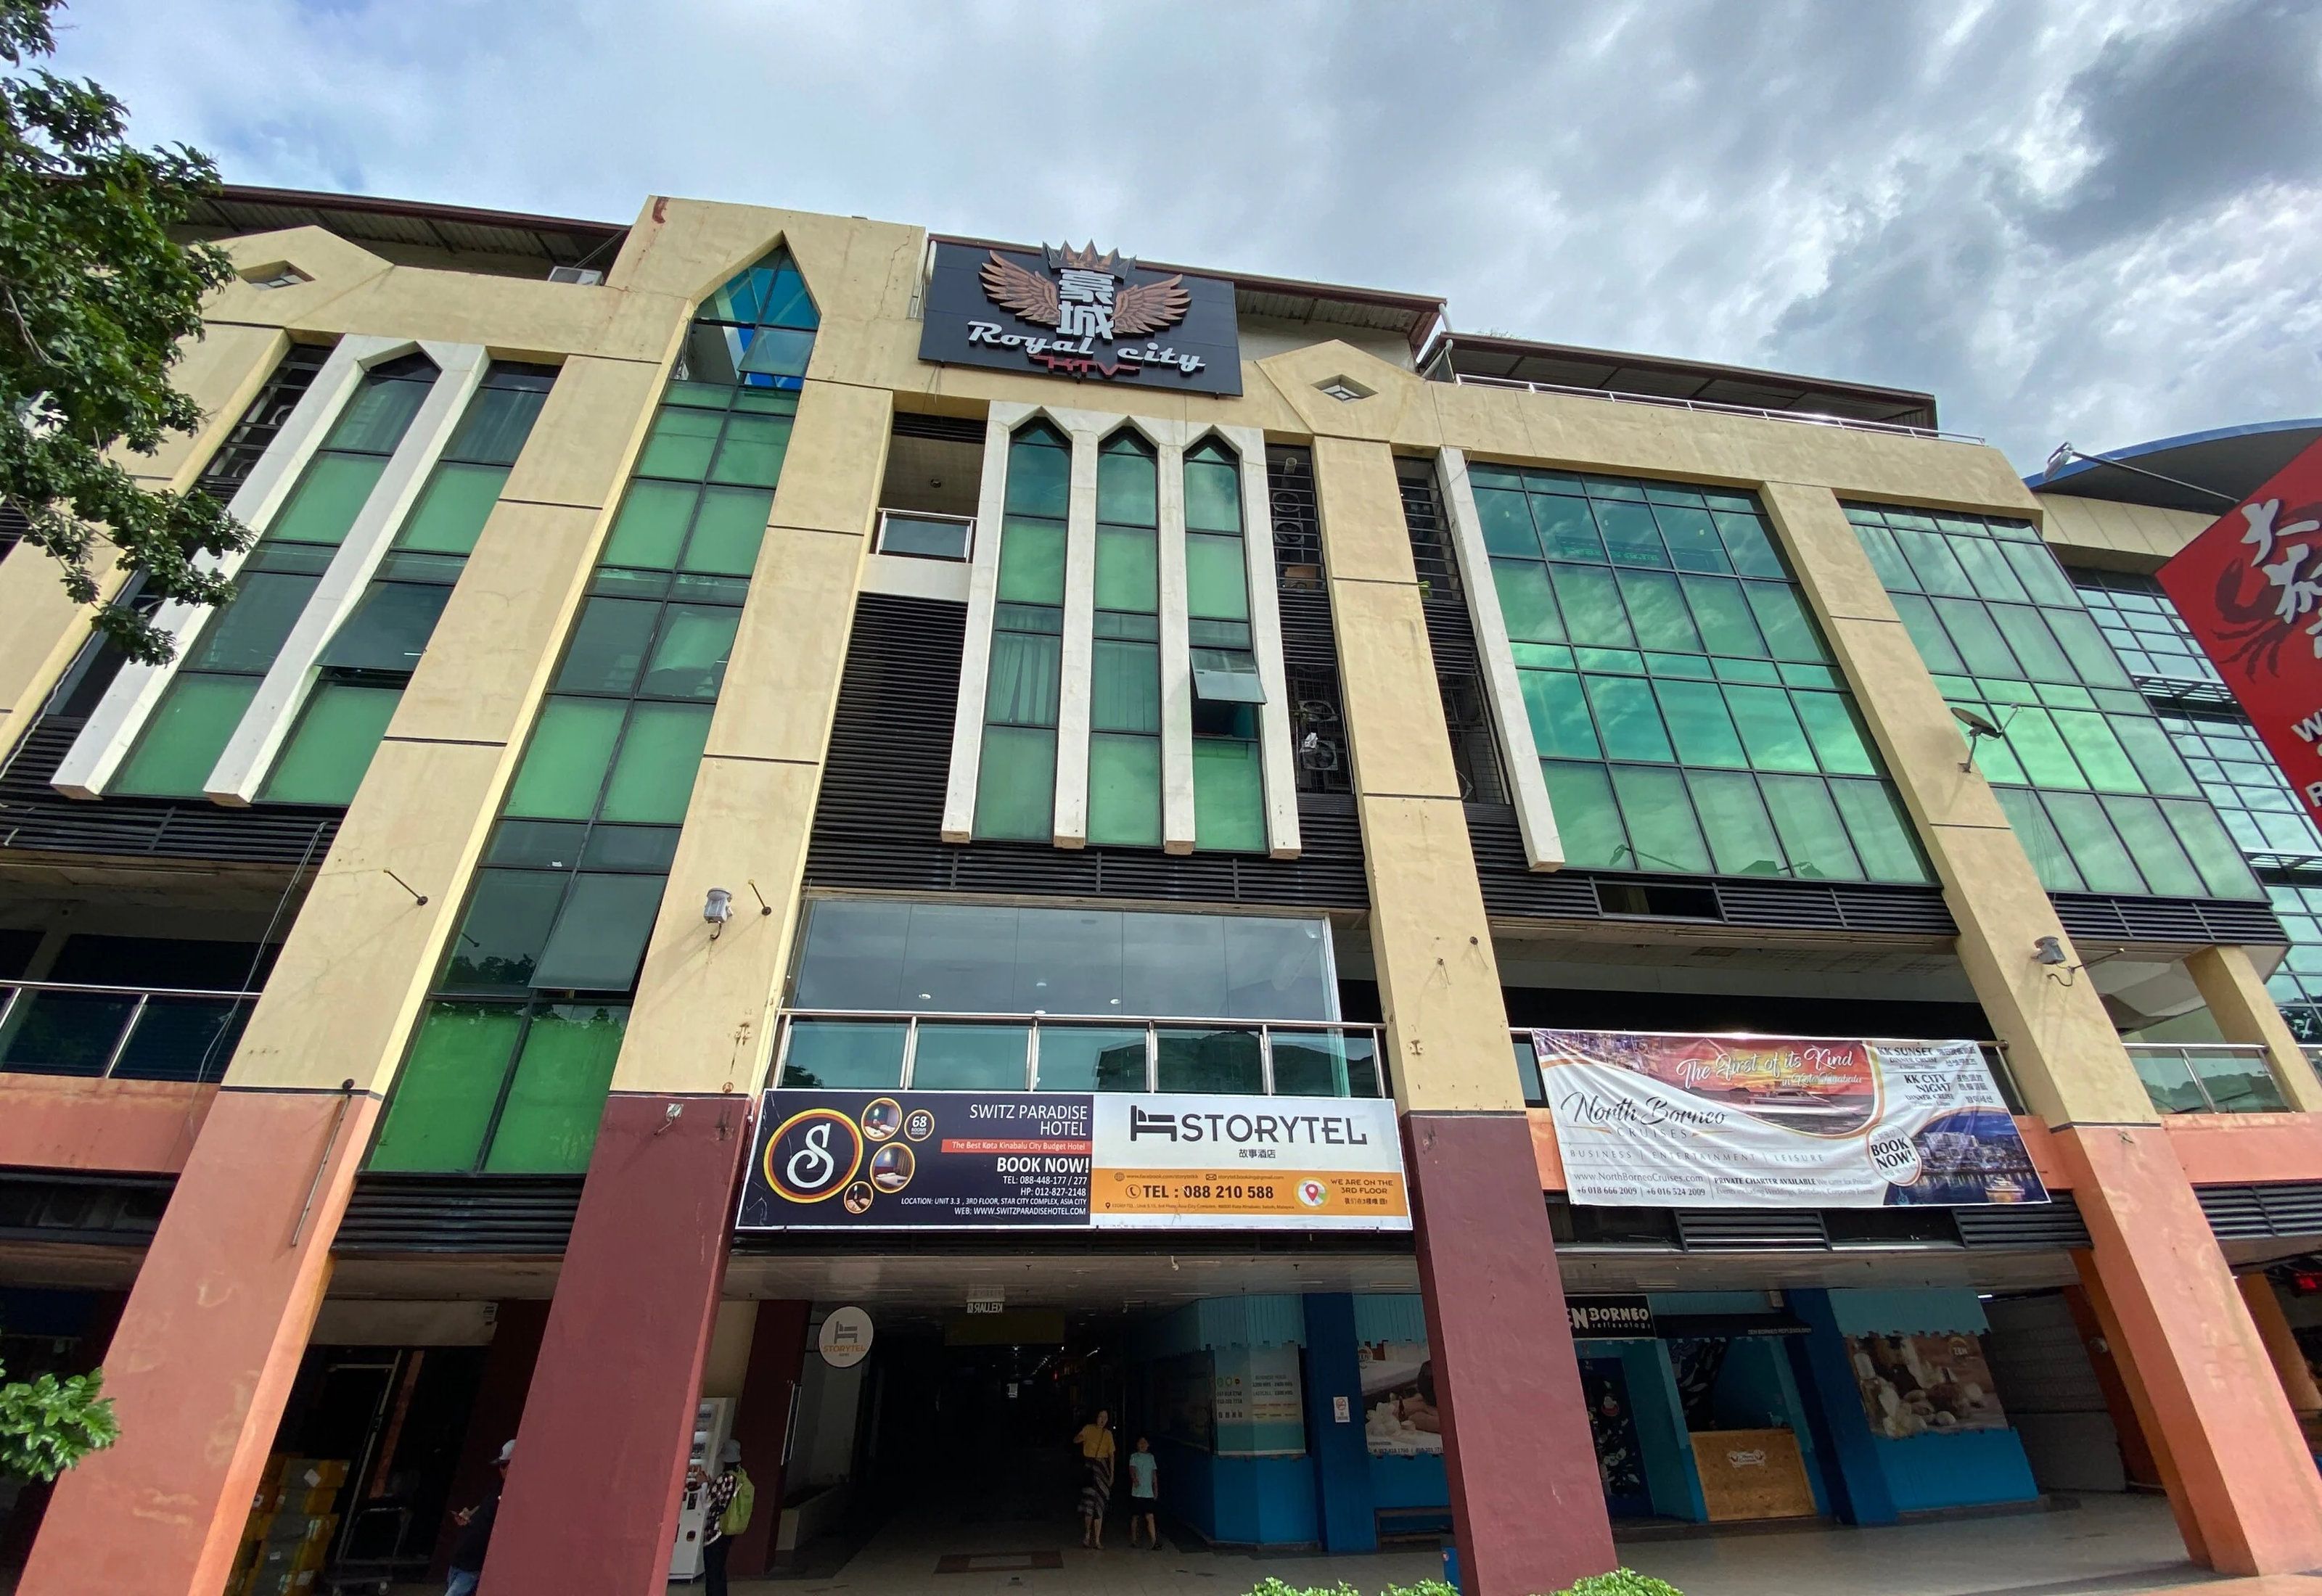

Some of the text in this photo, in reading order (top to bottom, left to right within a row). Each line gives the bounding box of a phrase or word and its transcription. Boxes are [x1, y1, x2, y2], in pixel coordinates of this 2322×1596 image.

[1057, 268, 1115, 341] 豪城
[967, 320, 1206, 374] Royal city
[1877, 1047, 1894, 1056] KK
[1895, 1047, 1933, 1056] SUNSET
[1676, 1048, 1853, 1089] The First of its Kind
[1903, 1074, 1946, 1084] KK CITY
[1916, 1082, 1952, 1093] NIGHT
[969, 1104, 1088, 1119] SWITZ PARADISE
[1560, 1091, 1728, 1124] North Borneo
[912, 1116, 927, 1127] 68
[1040, 1121, 1086, 1136] HOTEL
[1181, 1113, 1368, 1145] STORYTEL
[1617, 1127, 1687, 1138] CRUISES
[999, 1141, 1028, 1150] Kinabalu
[1029, 1142, 1041, 1151] City
[1043, 1143, 1066, 1151] Budget
[1870, 1137, 1910, 1156] BOOK
[1239, 1148, 1276, 1159] 故事酒店
[1570, 1150, 1631, 1159] BUSINESS
[1652, 1151, 1755, 1161] ENTERTAINMENT
[1875, 1150, 1916, 1169] NOW!
[997, 1157, 1089, 1173] BOOK NOW!
[1003, 1176, 1017, 1185] TEL:
[1020, 1176, 1066, 1185] 088-448-177
[1073, 1177, 1088, 1185] 277
[1574, 1172, 1703, 1182] www.NorthBorneoCruises.com
[1035, 1188, 1086, 1196] 012-827-2148
[1143, 1185, 1169, 1198] TEL
[1184, 1185, 1210, 1198] 088
[1215, 1185, 1242, 1198] 210
[1247, 1186, 1273, 1198] 588
[1589, 1307, 1650, 1322] BORNEO
[823, 1344, 867, 1353] STORYTEL
